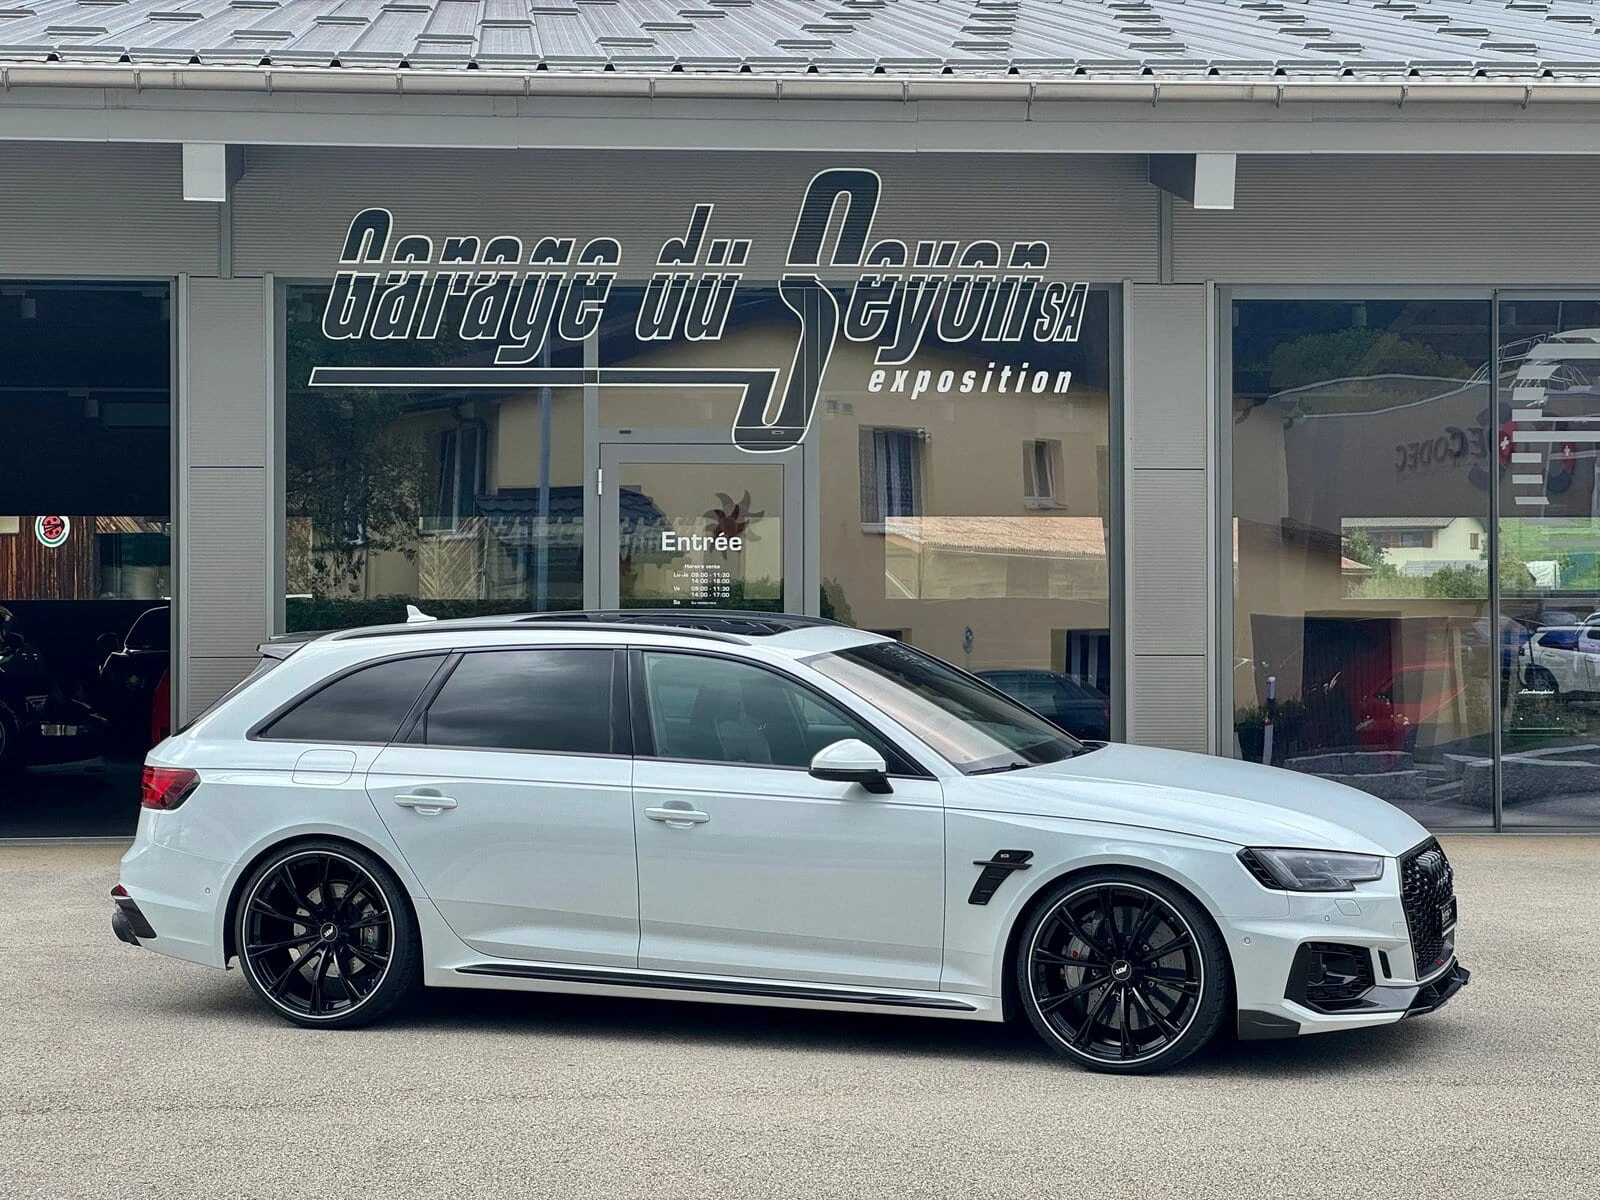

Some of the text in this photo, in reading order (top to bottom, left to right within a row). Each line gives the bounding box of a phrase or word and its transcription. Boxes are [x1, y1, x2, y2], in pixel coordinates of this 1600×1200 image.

[322, 168, 1089, 452] Garage du Seyon SA
[868, 362, 1072, 399] exposition
[661, 531, 742, 551] Entrée
